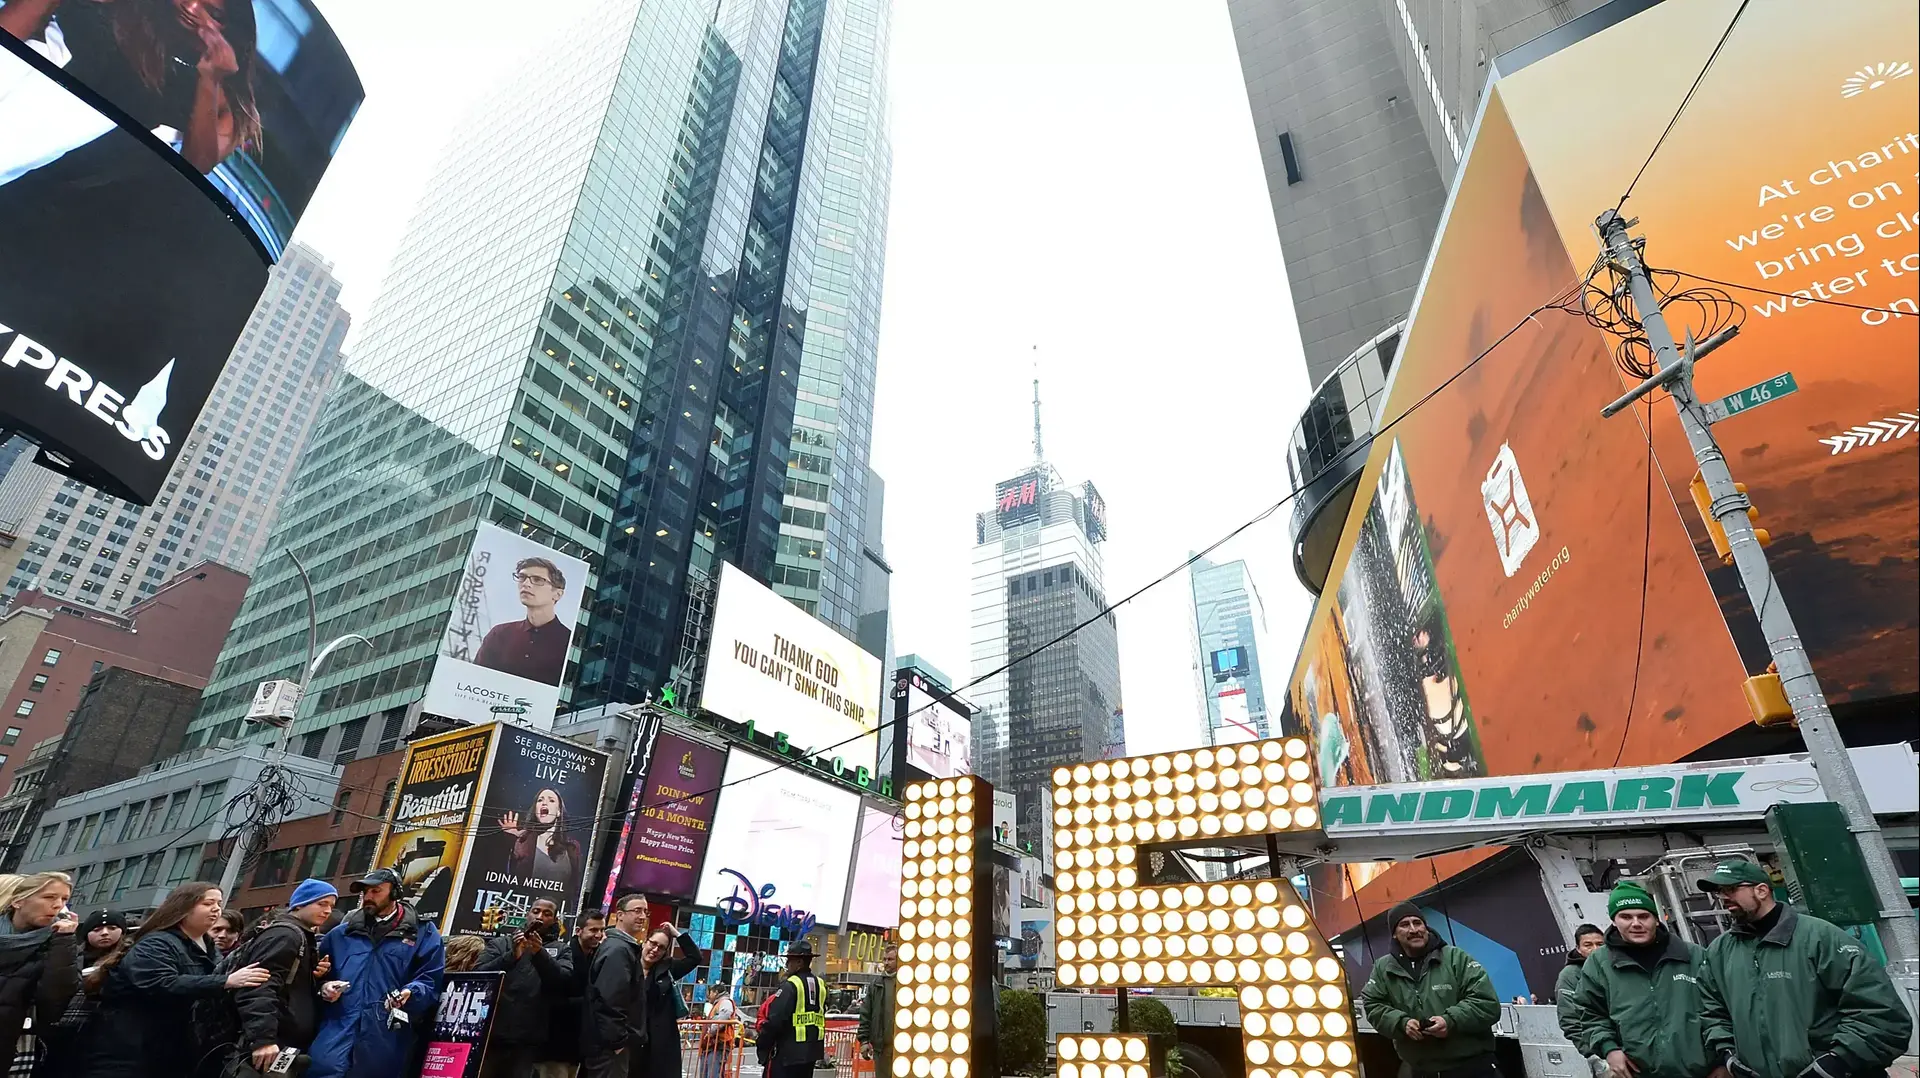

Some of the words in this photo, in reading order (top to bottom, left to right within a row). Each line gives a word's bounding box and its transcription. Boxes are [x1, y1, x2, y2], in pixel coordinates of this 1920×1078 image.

[1758, 180, 1800, 207] At
[1726, 205, 1835, 252] we're
[1848, 180, 1903, 209] on
[1754, 233, 1865, 280] bring
[1753, 268, 1868, 318] water
[1880, 253, 1919, 278] to
[1861, 297, 1919, 326] on
[0, 322, 171, 461] PRESS
[1728, 394, 1745, 412] W
[1750, 384, 1772, 403] 46
[1774, 375, 1789, 388] ST
[1503, 545, 1570, 629] charitywater.org
[774, 633, 813, 674] THANK
[816, 658, 839, 688] GOD
[456, 682, 510, 703] LACOSTE
[734, 639, 758, 669] YOU
[760, 654, 793, 687] CAN'T
[794, 672, 819, 701] SINK
[821, 686, 842, 712] THIS
[843, 699, 865, 725] SHIP.
[514, 735, 533, 748] SEE
[535, 741, 596, 767] BROADWAY'S
[520, 747, 563, 767] BIGGEST
[564, 760, 587, 774] STAR
[535, 763, 568, 785] LIVE
[396, 781, 474, 820] Beautiful
[656, 785, 680, 799] JOIN
[682, 791, 704, 806] NOW
[676, 803, 689, 812] just
[425, 816, 440, 828] King
[439, 811, 466, 826] Musical
[656, 809, 665, 820] A
[666, 812, 707, 831] MONTH.
[640, 836, 660, 848] Happy
[660, 841, 678, 851] Same
[678, 845, 695, 855] Price.
[646, 827, 666, 840] Happy
[666, 832, 680, 841] New
[680, 835, 694, 844] Year.
[485, 871, 519, 886] IDINA
[522, 877, 565, 892] MENZEL
[436, 992, 486, 1023] 2015
